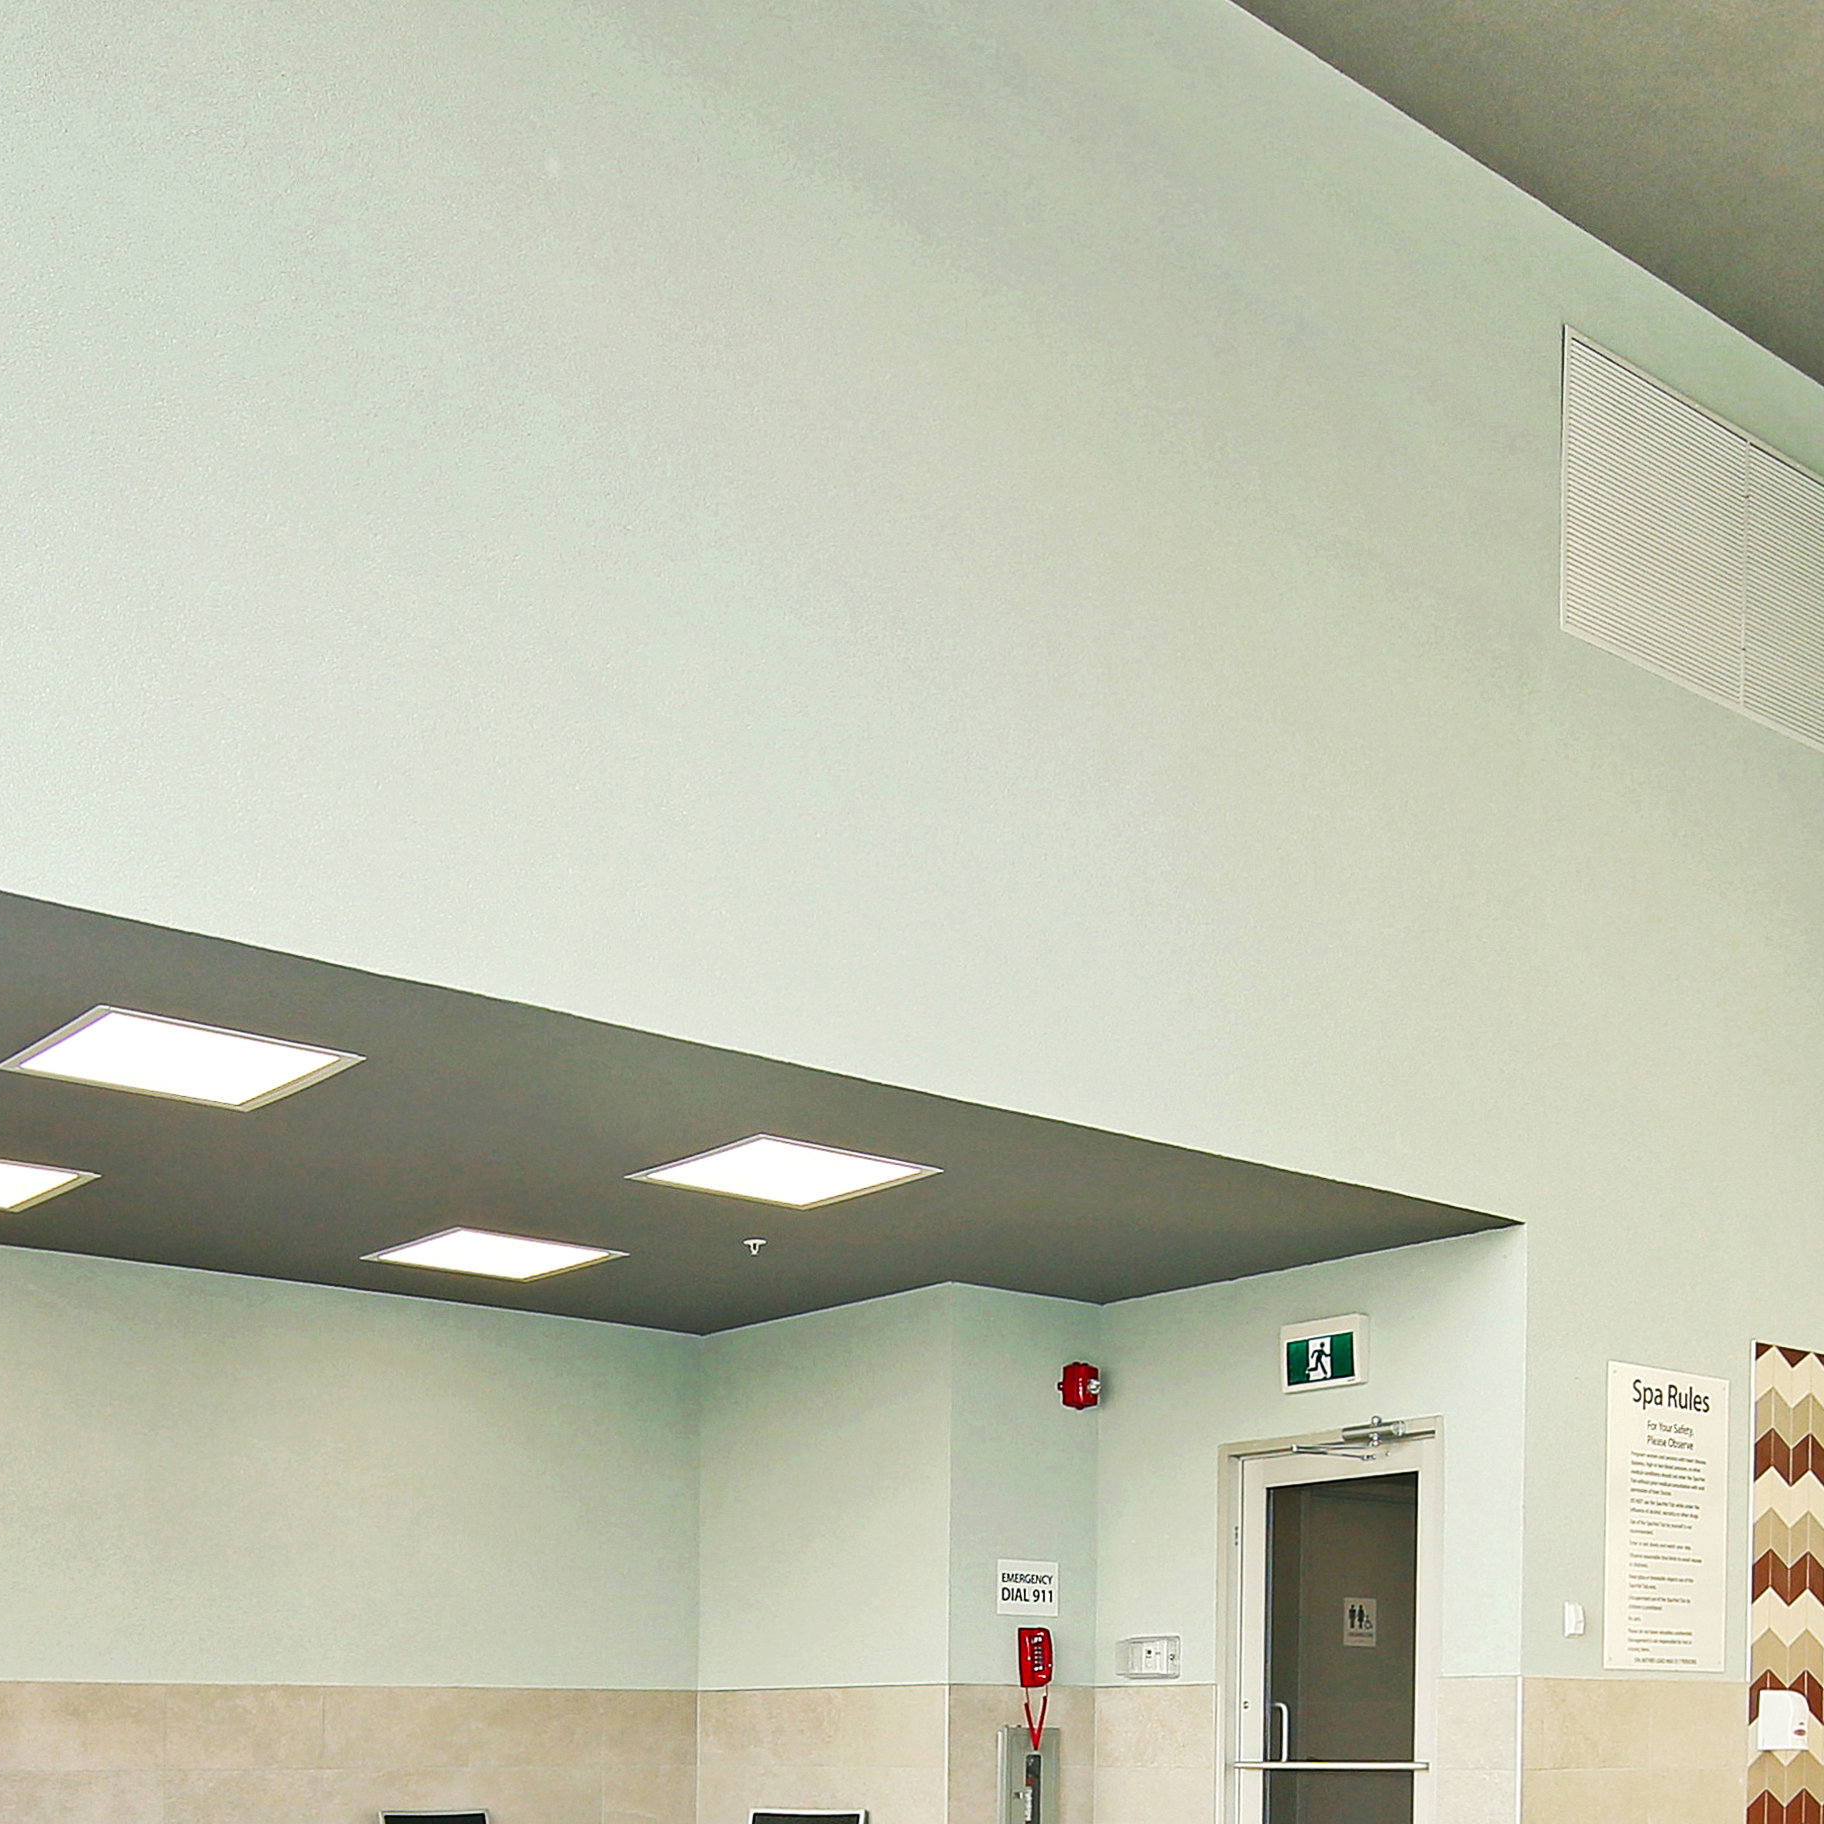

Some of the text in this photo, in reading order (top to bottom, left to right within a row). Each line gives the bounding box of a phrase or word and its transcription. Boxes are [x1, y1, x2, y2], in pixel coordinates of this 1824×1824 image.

[1632, 1379, 1710, 1413] Spa Rules
[1647, 1420, 1657, 1431] For
[1659, 1422, 1673, 1432] Your
[1647, 1435, 1694, 1450] Please Observe
[1001, 1572, 1054, 1585] EMERGENCY
[1001, 1586, 1053, 1603] DIAL 911
